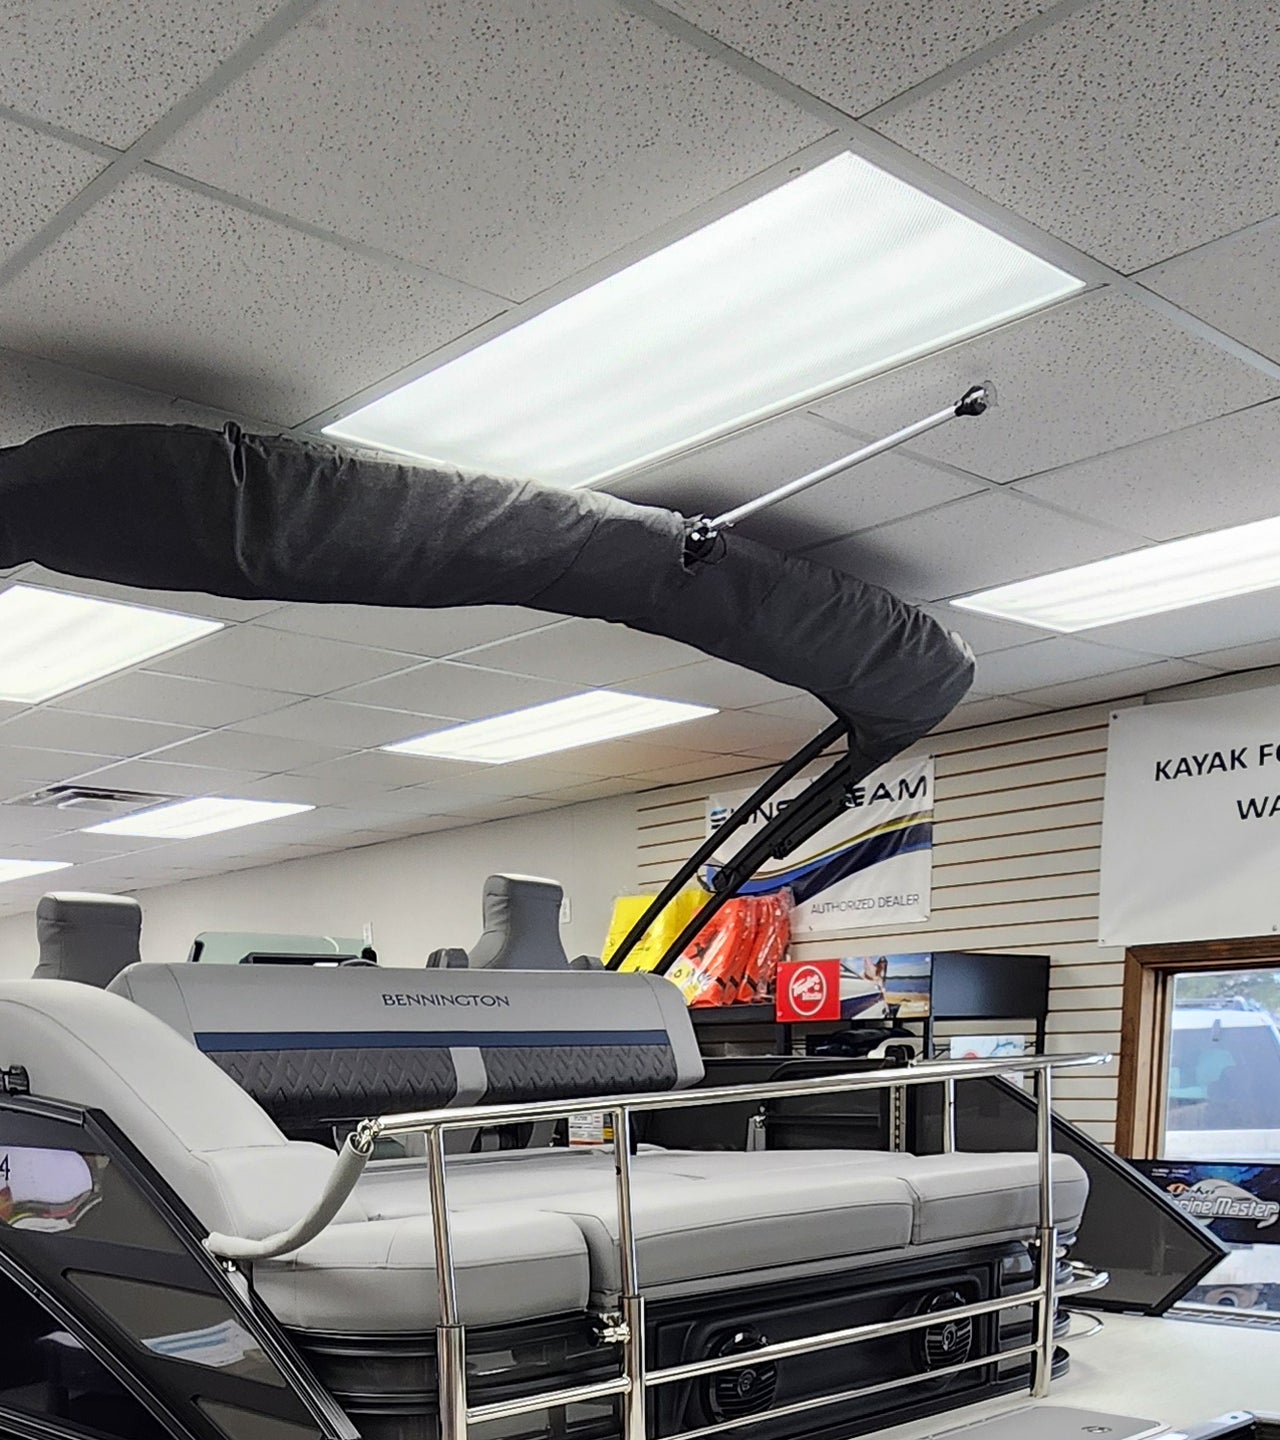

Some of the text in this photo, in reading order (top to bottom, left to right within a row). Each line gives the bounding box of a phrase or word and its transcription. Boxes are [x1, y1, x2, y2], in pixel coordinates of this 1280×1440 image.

[1154, 747, 1249, 782] KAYAK
[810, 893, 920, 915] AUTHORIZED DEALER
[381, 993, 511, 1008] BENNINGTON
[1213, 1197, 1278, 1218] Master
